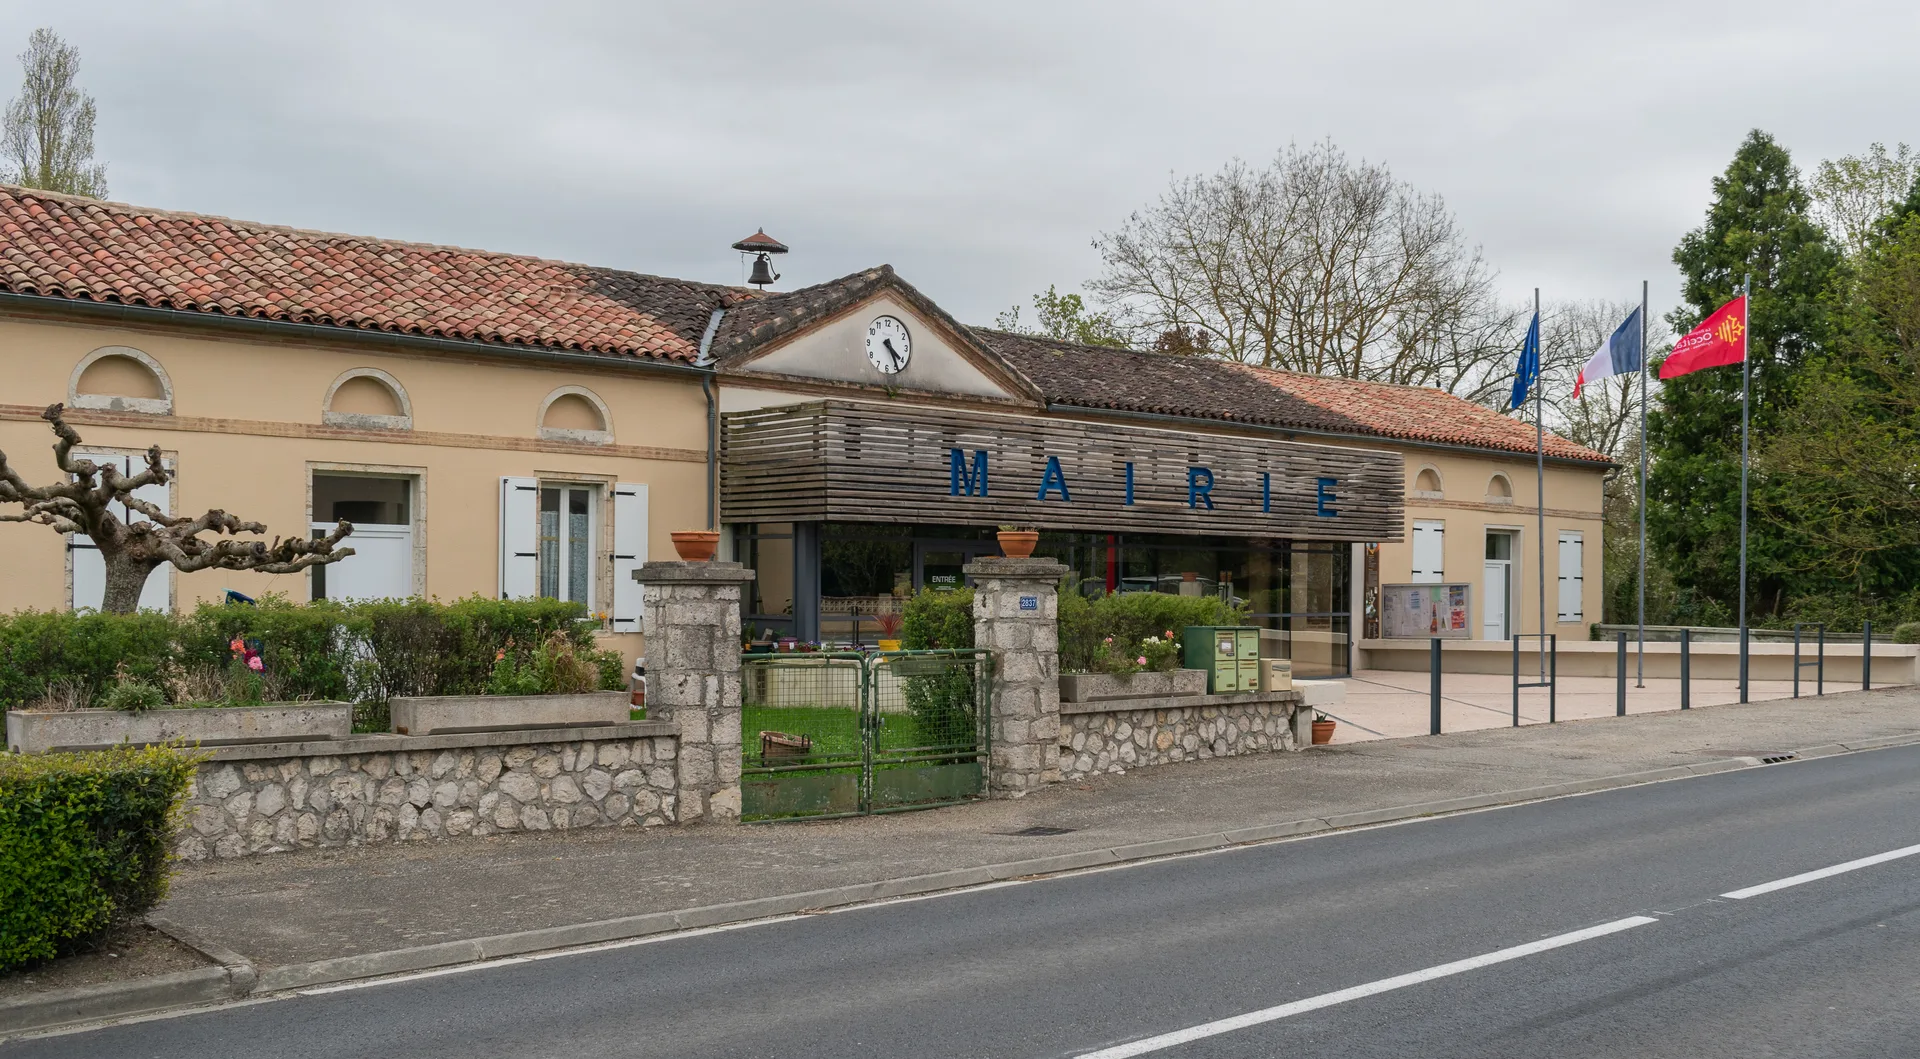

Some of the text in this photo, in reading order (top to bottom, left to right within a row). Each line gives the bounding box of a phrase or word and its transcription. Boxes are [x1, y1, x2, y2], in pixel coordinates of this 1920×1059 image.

[876, 321, 882, 329] 11
[869, 328, 876, 336] 10
[866, 338, 870, 346] 9
[877, 361, 880, 369] 7
[949, 448, 1339, 518] MAIRIE
[932, 574, 956, 584] ENTRÉE
[1022, 598, 1036, 607] 2837
